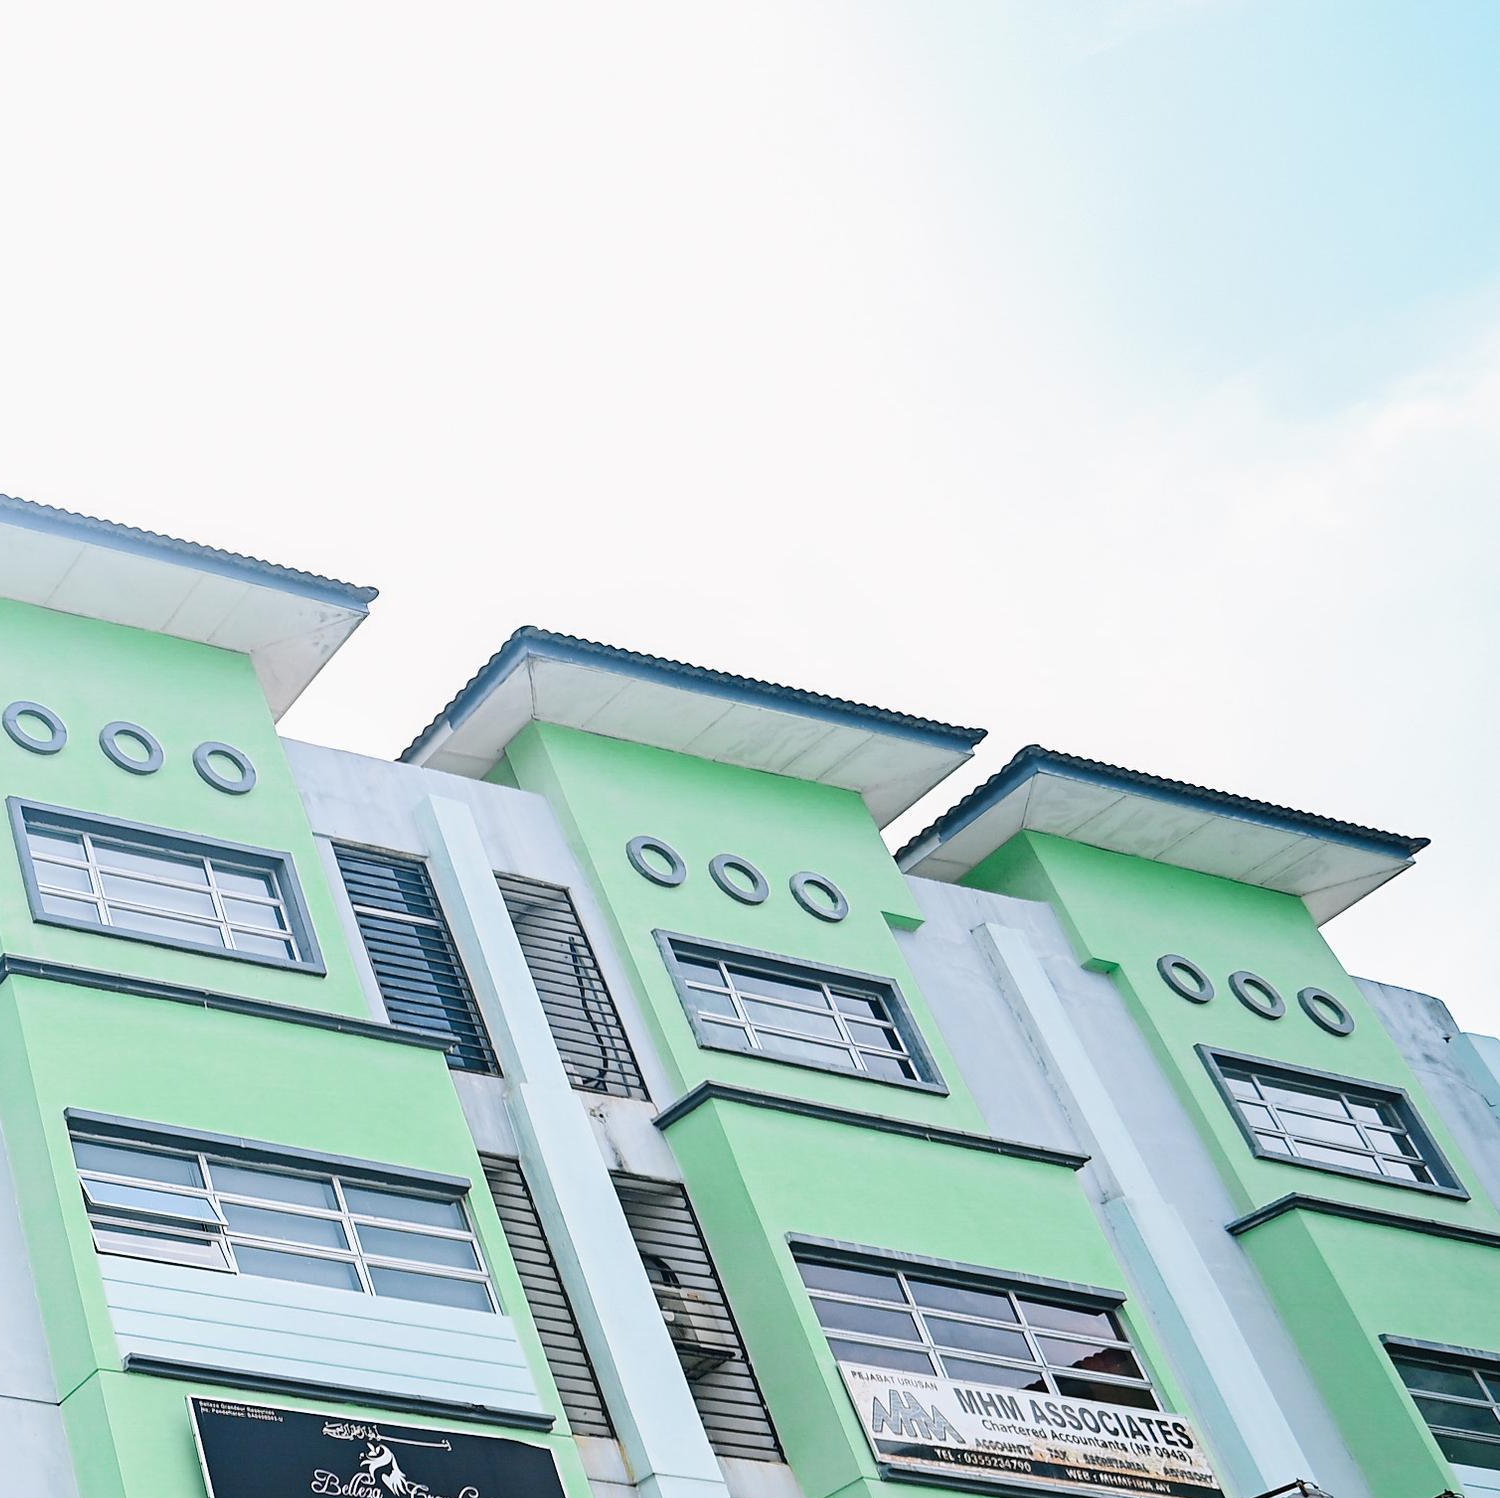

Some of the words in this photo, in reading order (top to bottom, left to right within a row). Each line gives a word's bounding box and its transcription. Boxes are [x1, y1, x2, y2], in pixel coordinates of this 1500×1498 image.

[851, 1370, 895, 1385] PEJABAT
[898, 1377, 938, 1391] URUSAN
[953, 1387, 1026, 1422] MHM
[1029, 1399, 1194, 1449] ASSOCIATES
[982, 1419, 1047, 1439] Chartered
[1051, 1430, 1128, 1452] Accountants
[1156, 1446, 1193, 1466] 0948)
[934, 1448, 953, 1461] TEL
[1064, 1468, 1091, 1482] WEB
